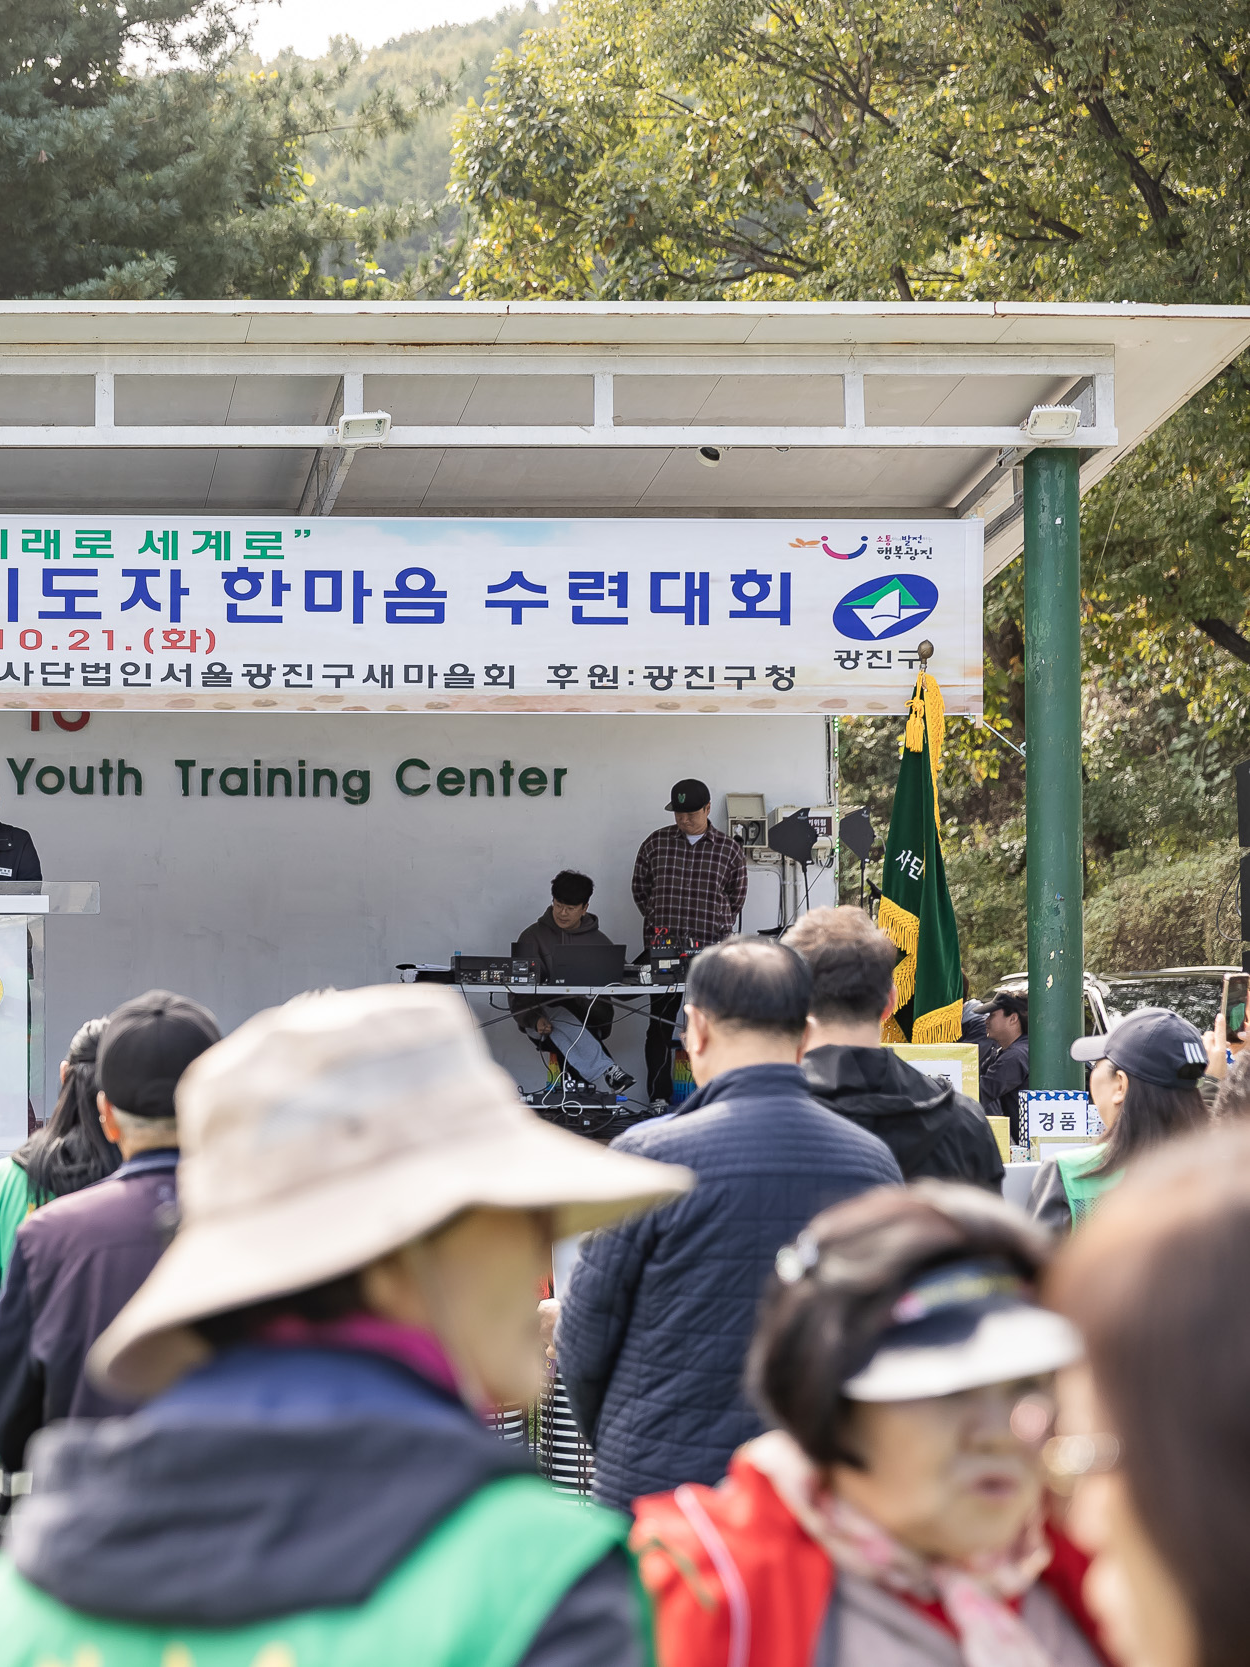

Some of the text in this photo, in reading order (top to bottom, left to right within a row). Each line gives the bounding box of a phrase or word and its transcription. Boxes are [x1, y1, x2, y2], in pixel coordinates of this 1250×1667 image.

[138, 529, 311, 561] 세계로”
[876, 546, 933, 561] 행복광진
[221, 566, 448, 625] 한마음
[484, 568, 792, 626] 수련대회
[833, 649, 922, 670] 광진구
[546, 663, 796, 692] 후원:광진구청
[9, 757, 141, 796] Youth
[177, 758, 370, 805] Training
[397, 758, 567, 797] Center
[1038, 1111, 1077, 1132] 경품
